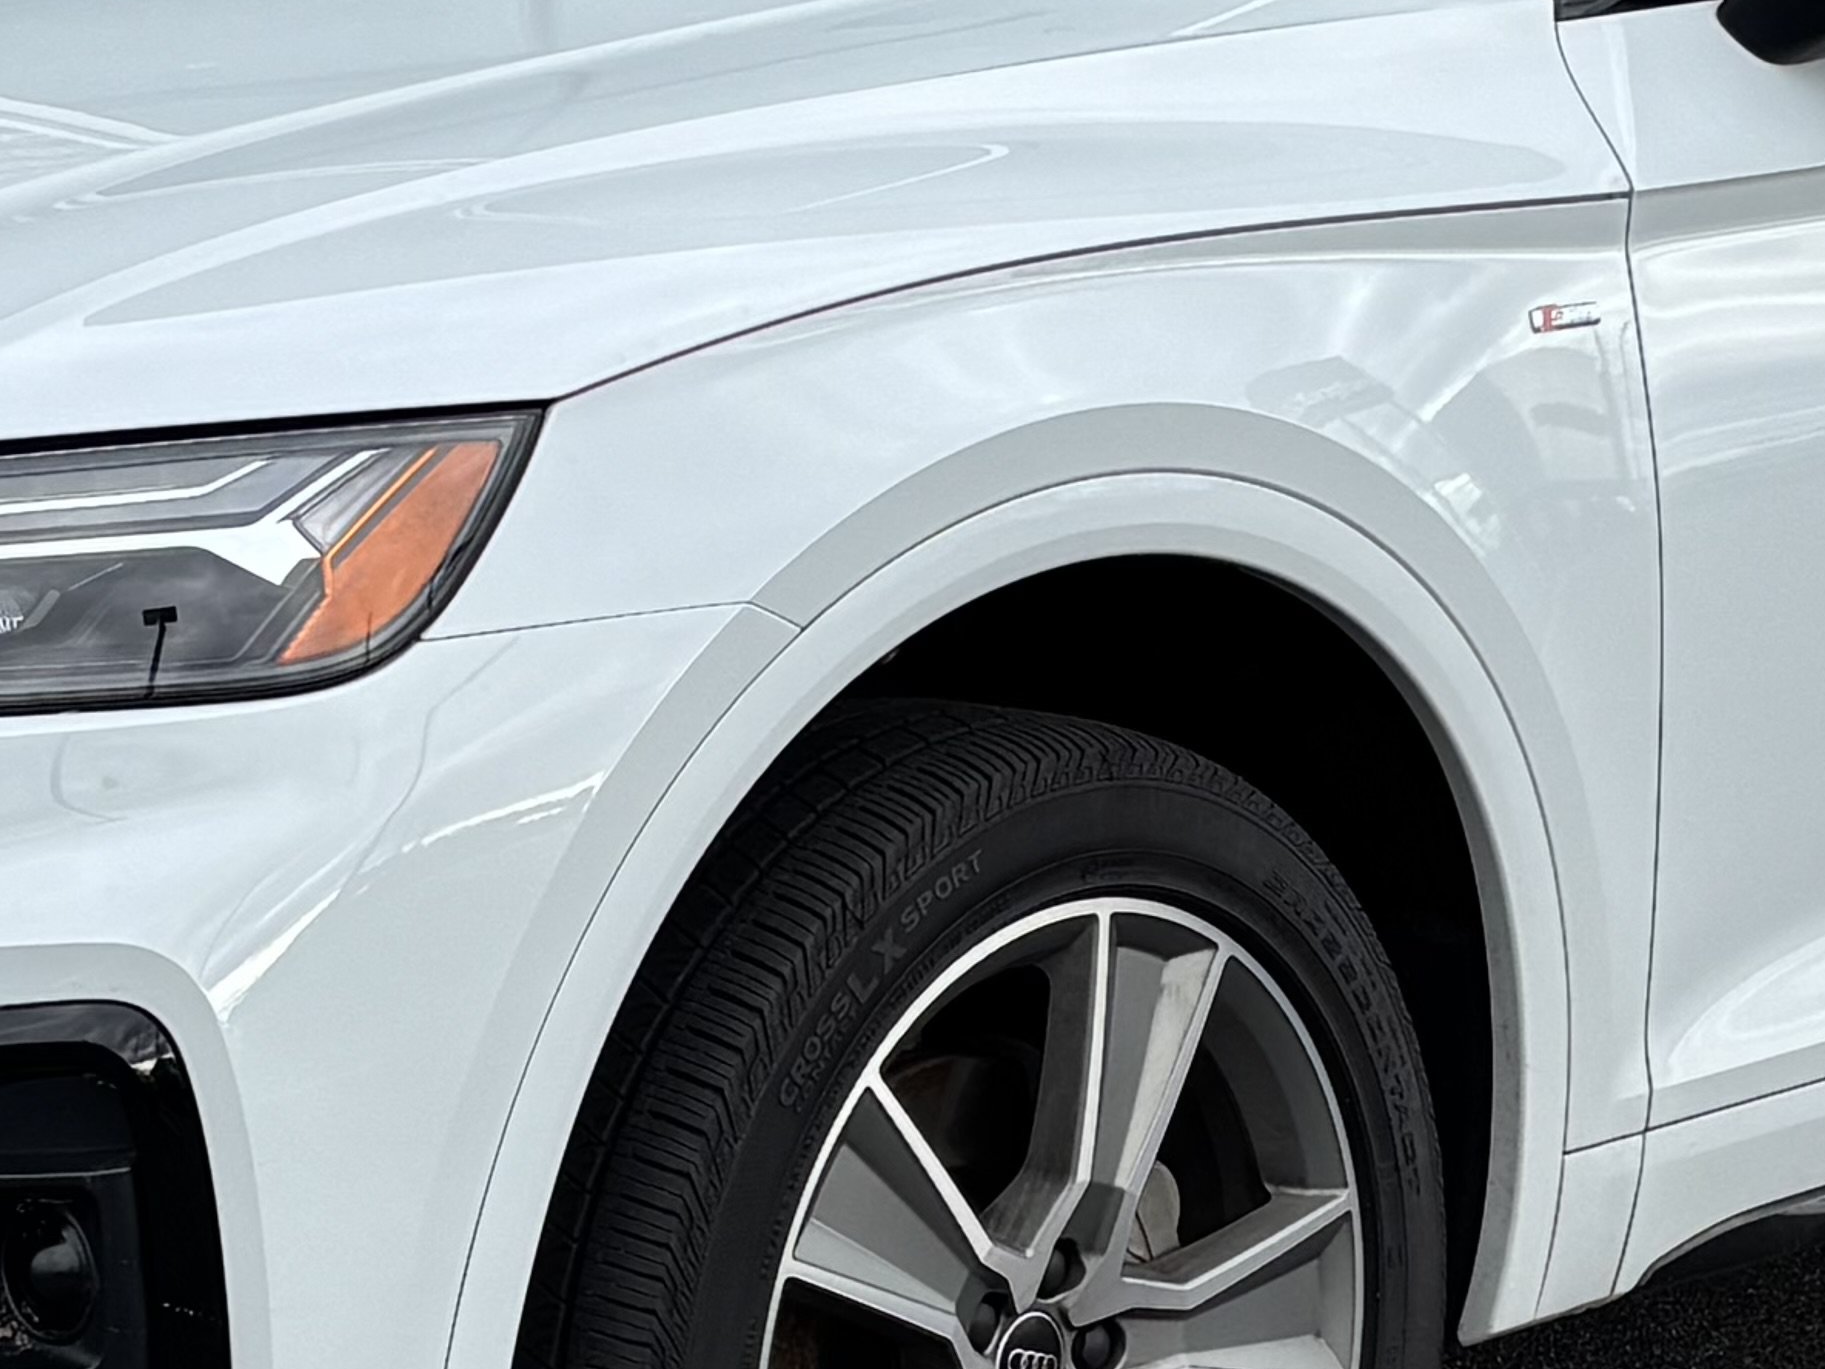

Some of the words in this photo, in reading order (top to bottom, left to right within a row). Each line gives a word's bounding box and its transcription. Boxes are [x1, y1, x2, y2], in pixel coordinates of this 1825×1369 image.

[780, 992, 851, 1107] CROSS
[847, 927, 907, 1005] LX
[900, 848, 983, 933] SPORT
